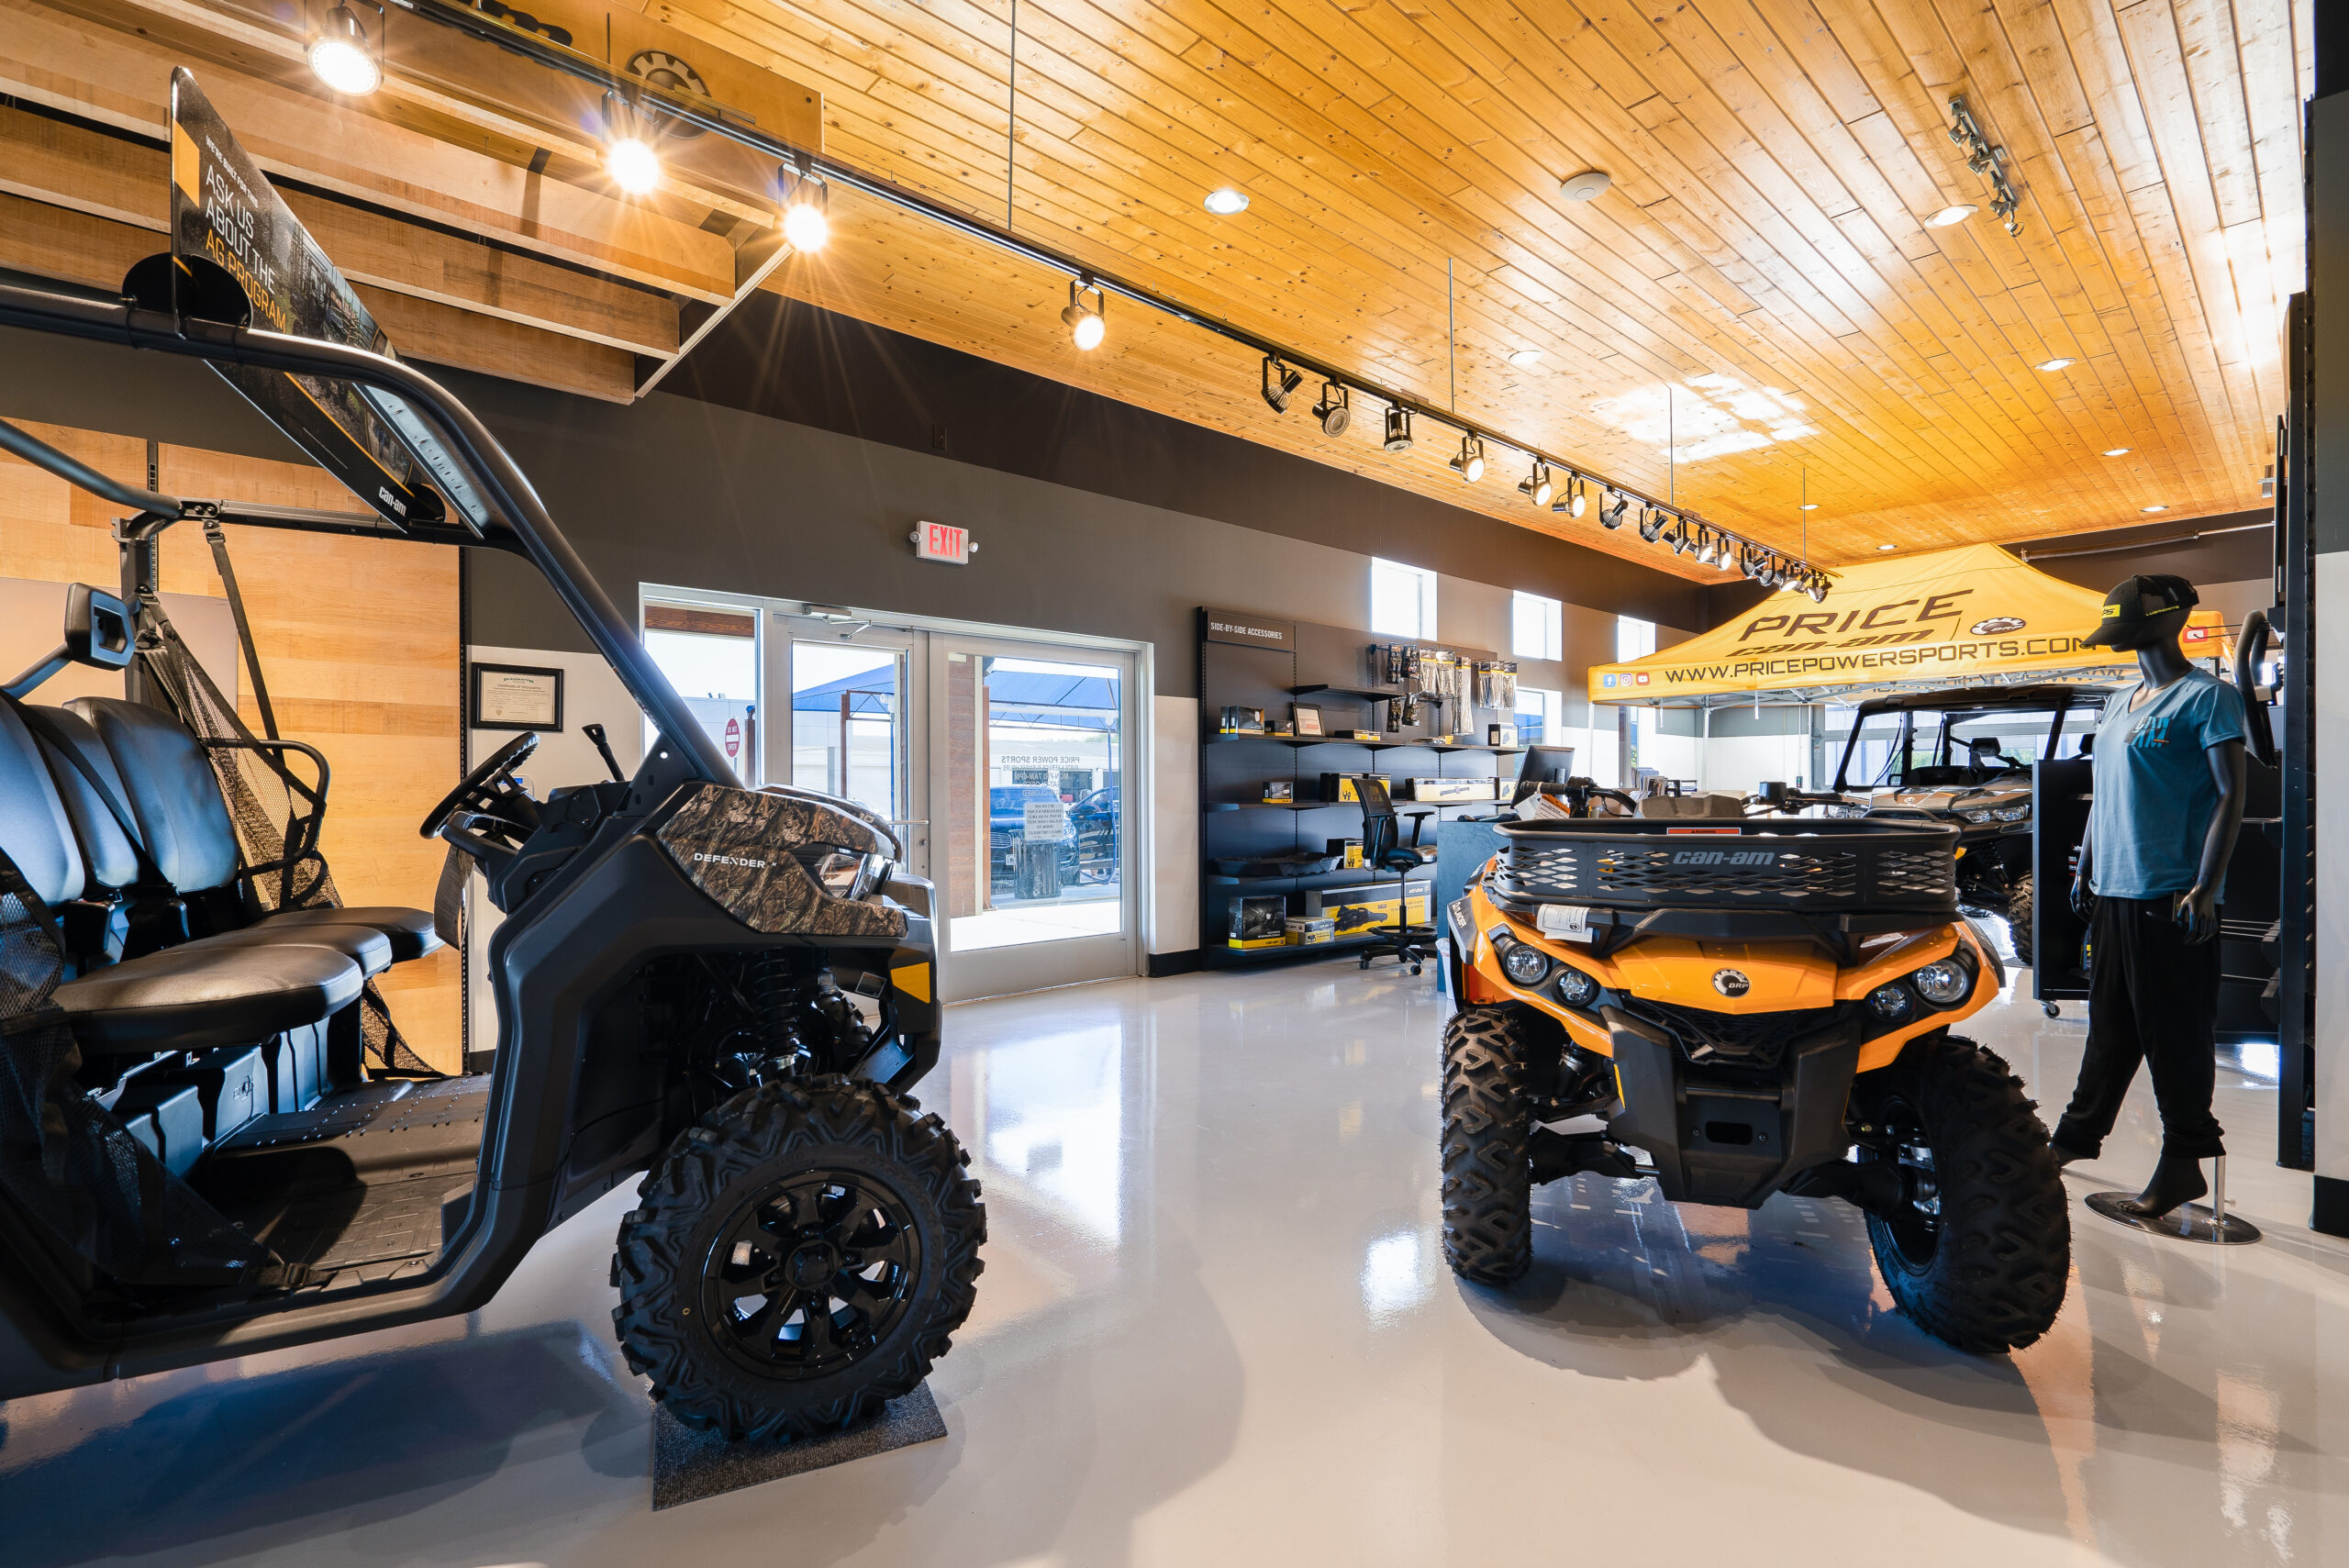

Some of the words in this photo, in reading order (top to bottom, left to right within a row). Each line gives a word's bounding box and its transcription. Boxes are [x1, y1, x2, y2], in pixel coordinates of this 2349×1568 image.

[206, 135, 223, 163] WE'RE
[222, 156, 238, 183] BUILT
[237, 174, 248, 195] FOR
[206, 163, 234, 217] ASK
[236, 199, 254, 239] US
[206, 195, 250, 264] ABOUT
[252, 247, 275, 295] THE
[206, 228, 225, 267] AG
[228, 250, 286, 335] PROGRAM
[378, 484, 407, 518] can-am
[929, 524, 963, 559] EXIT
[1210, 622, 1247, 635] SIDE-BY-SIDE
[1247, 628, 1283, 640] ACCESSORIES
[1738, 588, 1975, 642] PRICE
[1989, 624, 2024, 633] BRP
[1725, 628, 1935, 658] can-am
[1664, 637, 2098, 684] WWW.PRICEPOWERSPORTS.COM
[694, 852, 766, 869] DEFENDER
[1673, 851, 1776, 866] can-am
[1452, 901, 1467, 929] OUTLANDER
